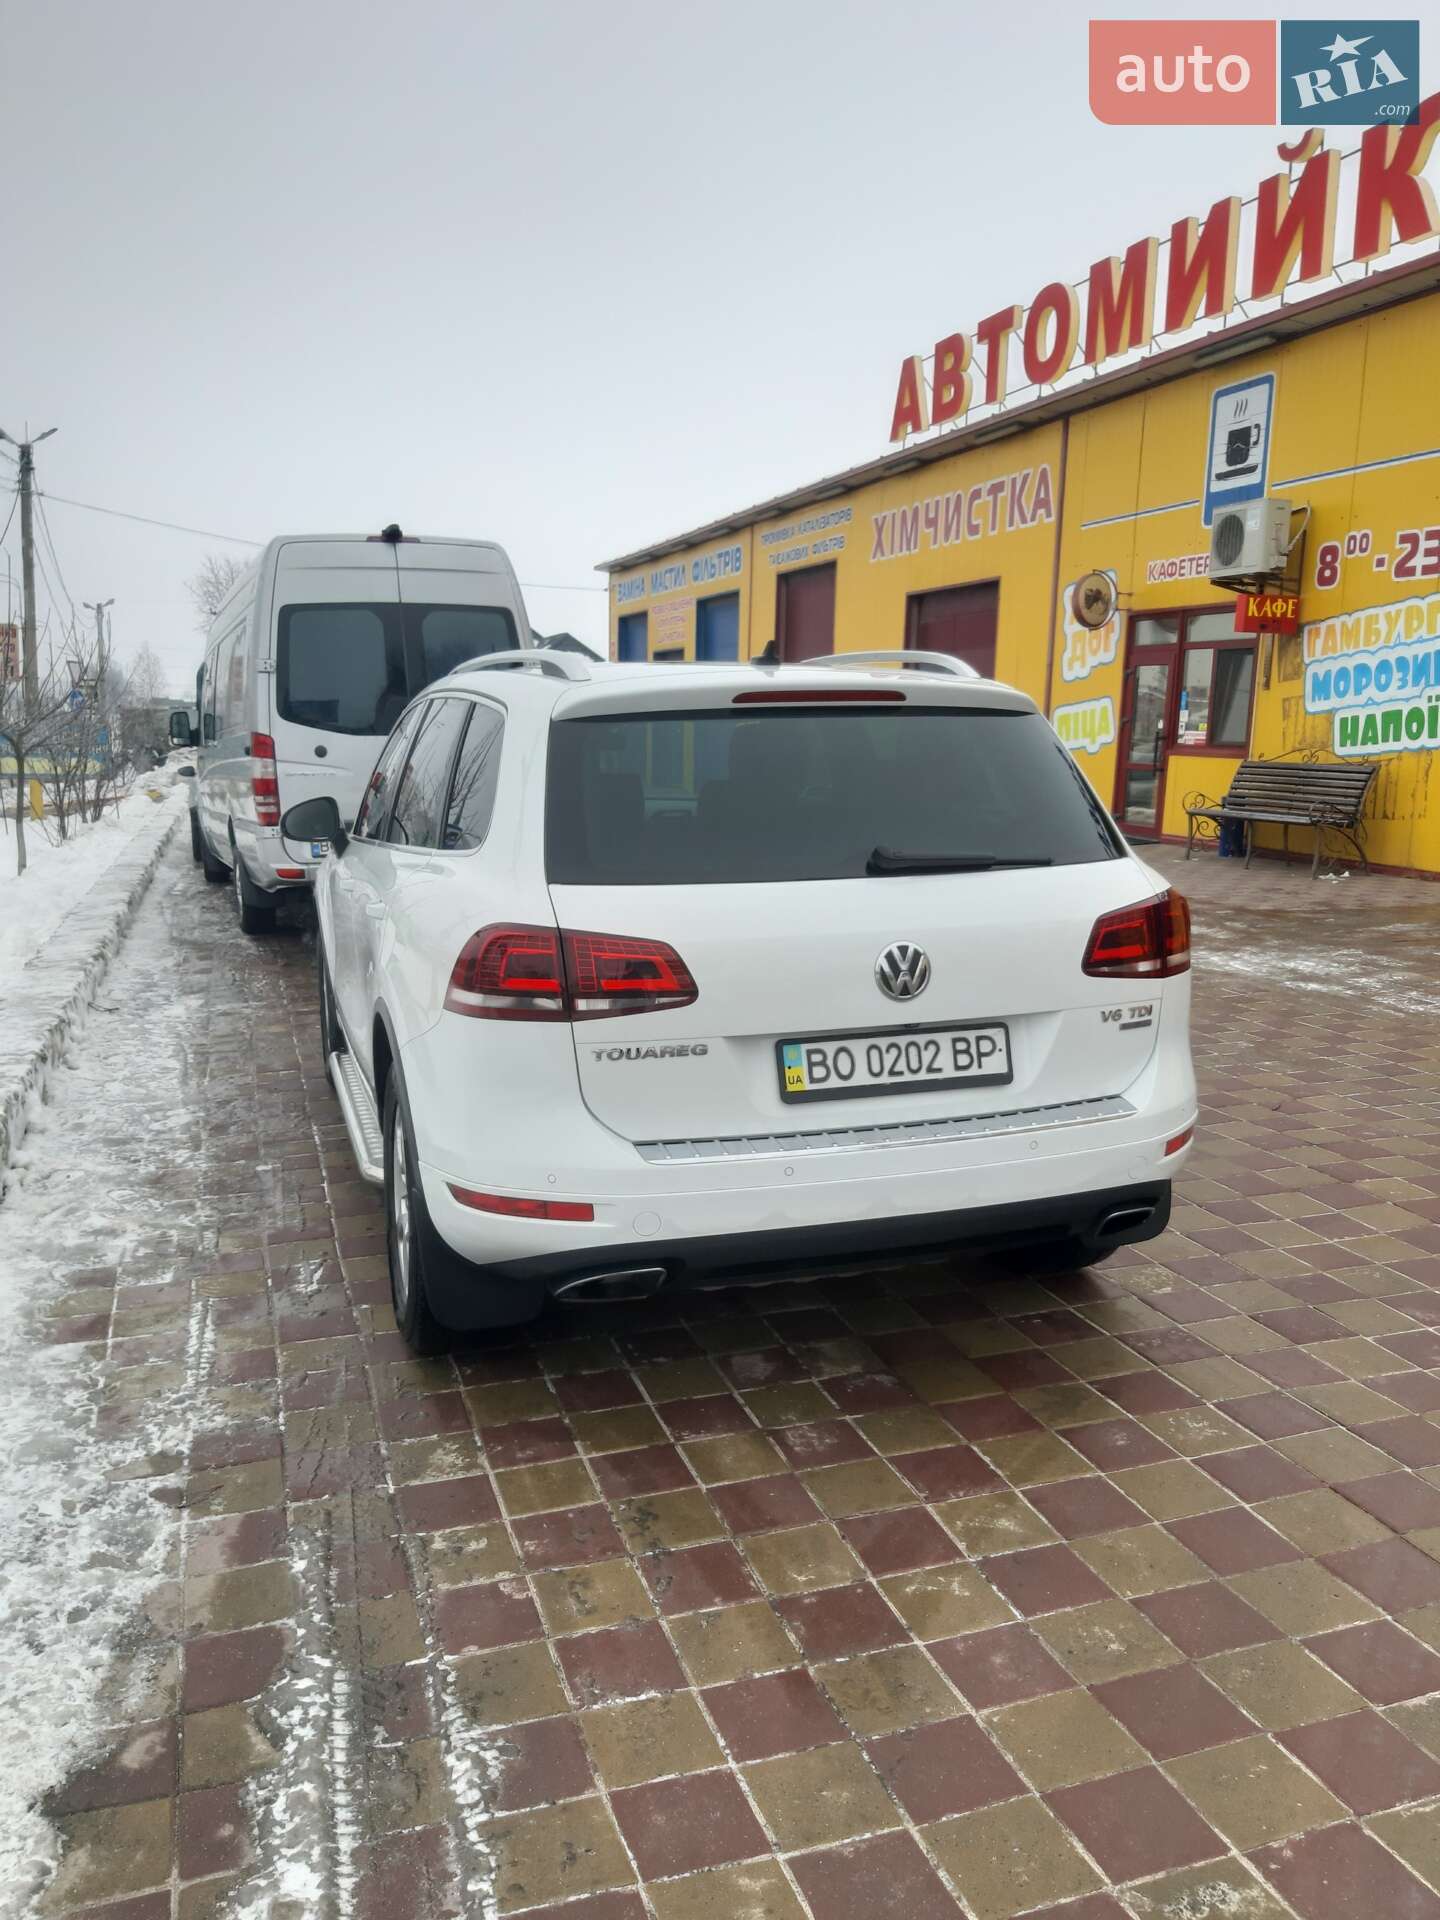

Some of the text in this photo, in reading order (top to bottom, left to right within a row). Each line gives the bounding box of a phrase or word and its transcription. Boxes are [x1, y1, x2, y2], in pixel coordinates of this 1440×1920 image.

[871, 466, 1053, 560] ХІМЧИСТКА
[617, 546, 742, 603] ЗАМІНА МАСТИЛ ФІЛЬТРІВ
[1248, 597, 1298, 618] КАФЕ
[1056, 704, 1111, 746] ПІЦА
[1339, 695, 1440, 747] НАПОЇ
[1100, 1004, 1152, 1023] V6 TDI
[591, 1043, 709, 1062] TOUAREG
[806, 1046, 856, 1084] BO
[866, 1040, 943, 1077] 0202
[787, 1076, 804, 1086] UA
